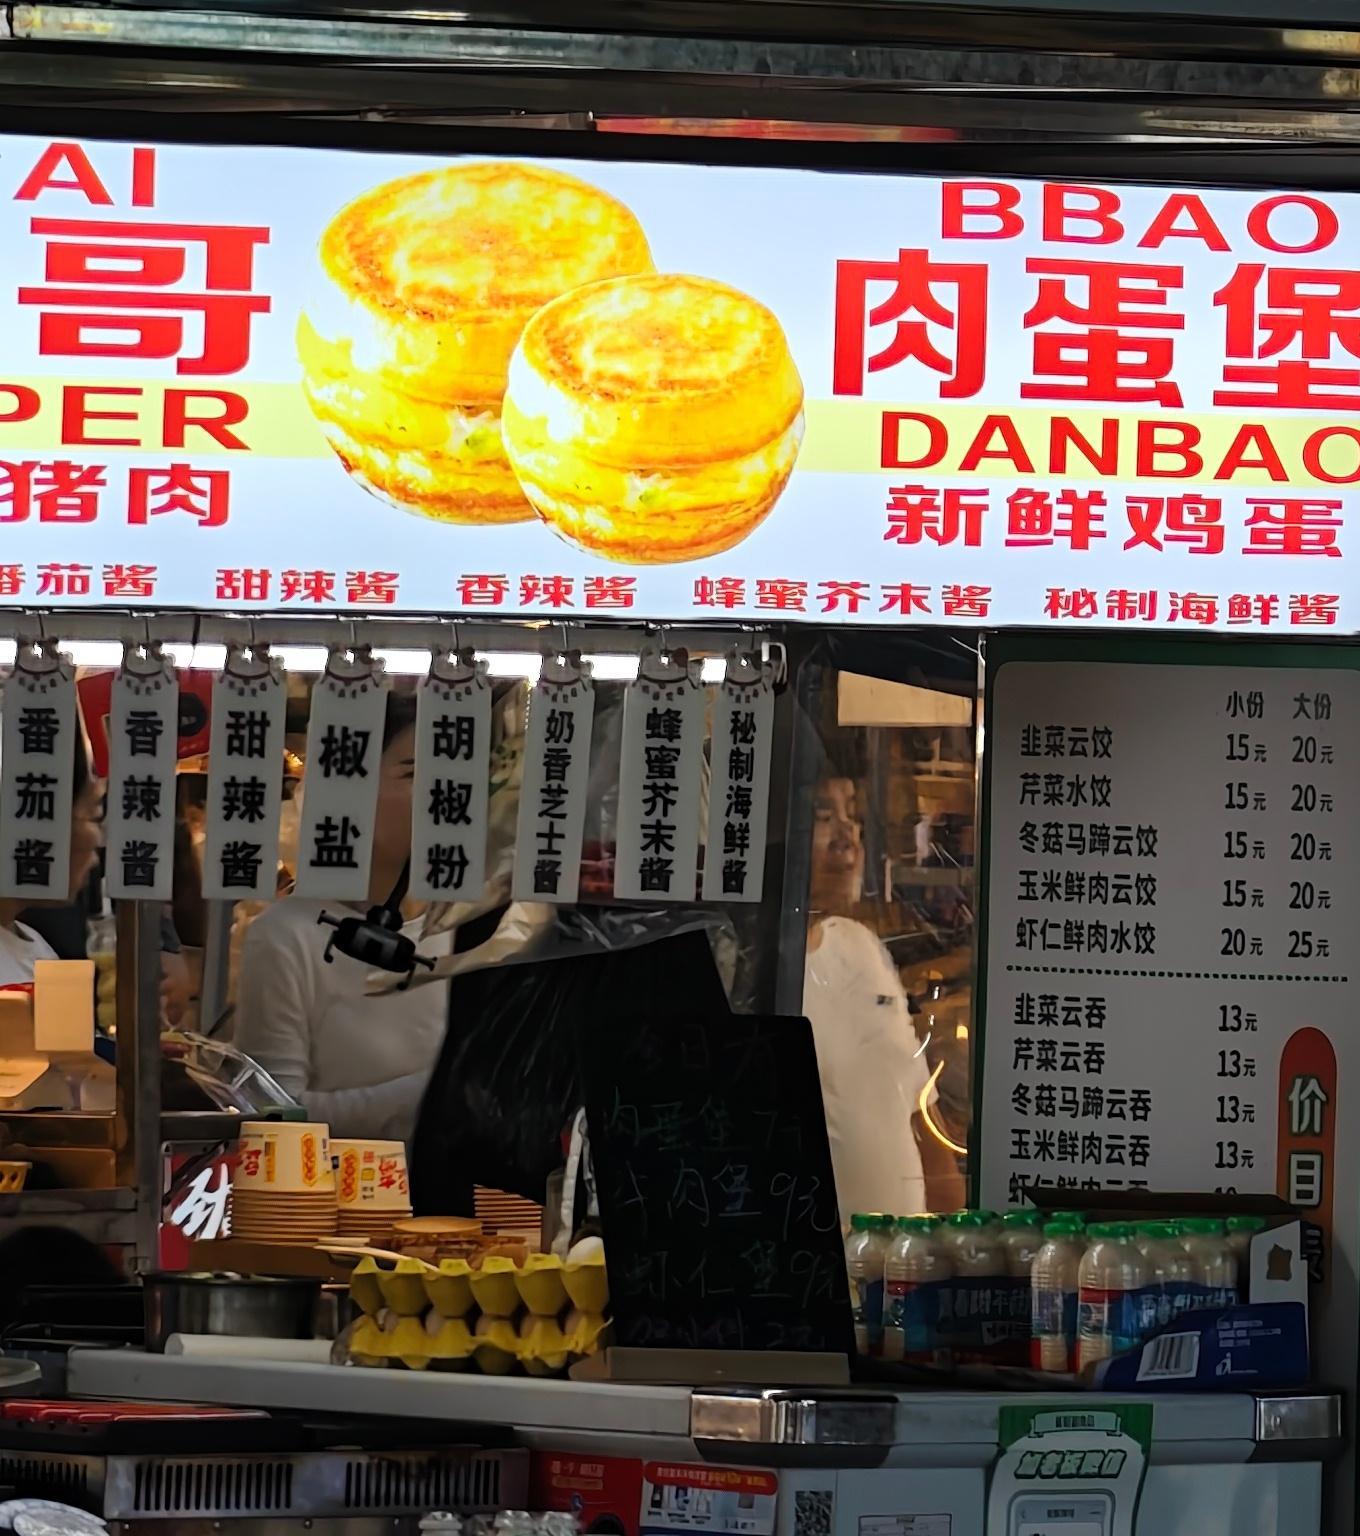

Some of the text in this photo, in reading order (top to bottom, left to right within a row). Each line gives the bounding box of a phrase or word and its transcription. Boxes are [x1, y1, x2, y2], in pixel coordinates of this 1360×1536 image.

[13, 142, 156, 207] AI
[941, 181, 1340, 253] BBAO
[17, 217, 271, 376] 哥
[0, 460, 231, 527] 猪肉
[884, 486, 1344, 559] 新鲜鸡蛋
[215, 568, 400, 604] 甜辣酱
[456, 574, 637, 609] 香辣酱
[693, 576, 992, 618] 蜂蜜芥末酱
[1044, 588, 1341, 627] 秘制海鲜酱
[1226, 691, 1332, 721] 小份 大份
[1020, 723, 1334, 764] 韭菜云饺 15元 20元
[14, 707, 60, 887] 番茄酱
[120, 710, 164, 888] 香辣酱
[220, 710, 271, 889] 甜辣酱
[310, 725, 371, 869] 椒盐
[426, 715, 476, 890] 胡椒粉
[533, 708, 575, 895] 奶香芝士酱
[639, 707, 683, 894] 蜂蜜芥末酱
[722, 709, 757, 895] 秘制海鲜酱
[1020, 772, 1333, 812] 芹菜水饺 15元 20元
[1019, 821, 1332, 861] 冬菇马蹄云饺 15元 20元
[1017, 870, 1331, 910] 玉米鲜肉云饺 15元 20元
[1015, 917, 1330, 959] 虾仁鲜肉水饺 20元 25元
[1014, 993, 1258, 1033] 韭菜云吞 13元
[1013, 1038, 1256, 1078] 芹菜云吞 13元
[1011, 1083, 1255, 1123] 冬菇马蹄云吞 13元
[1010, 1128, 1254, 1169] 玉米鲜肉云吞 13元
